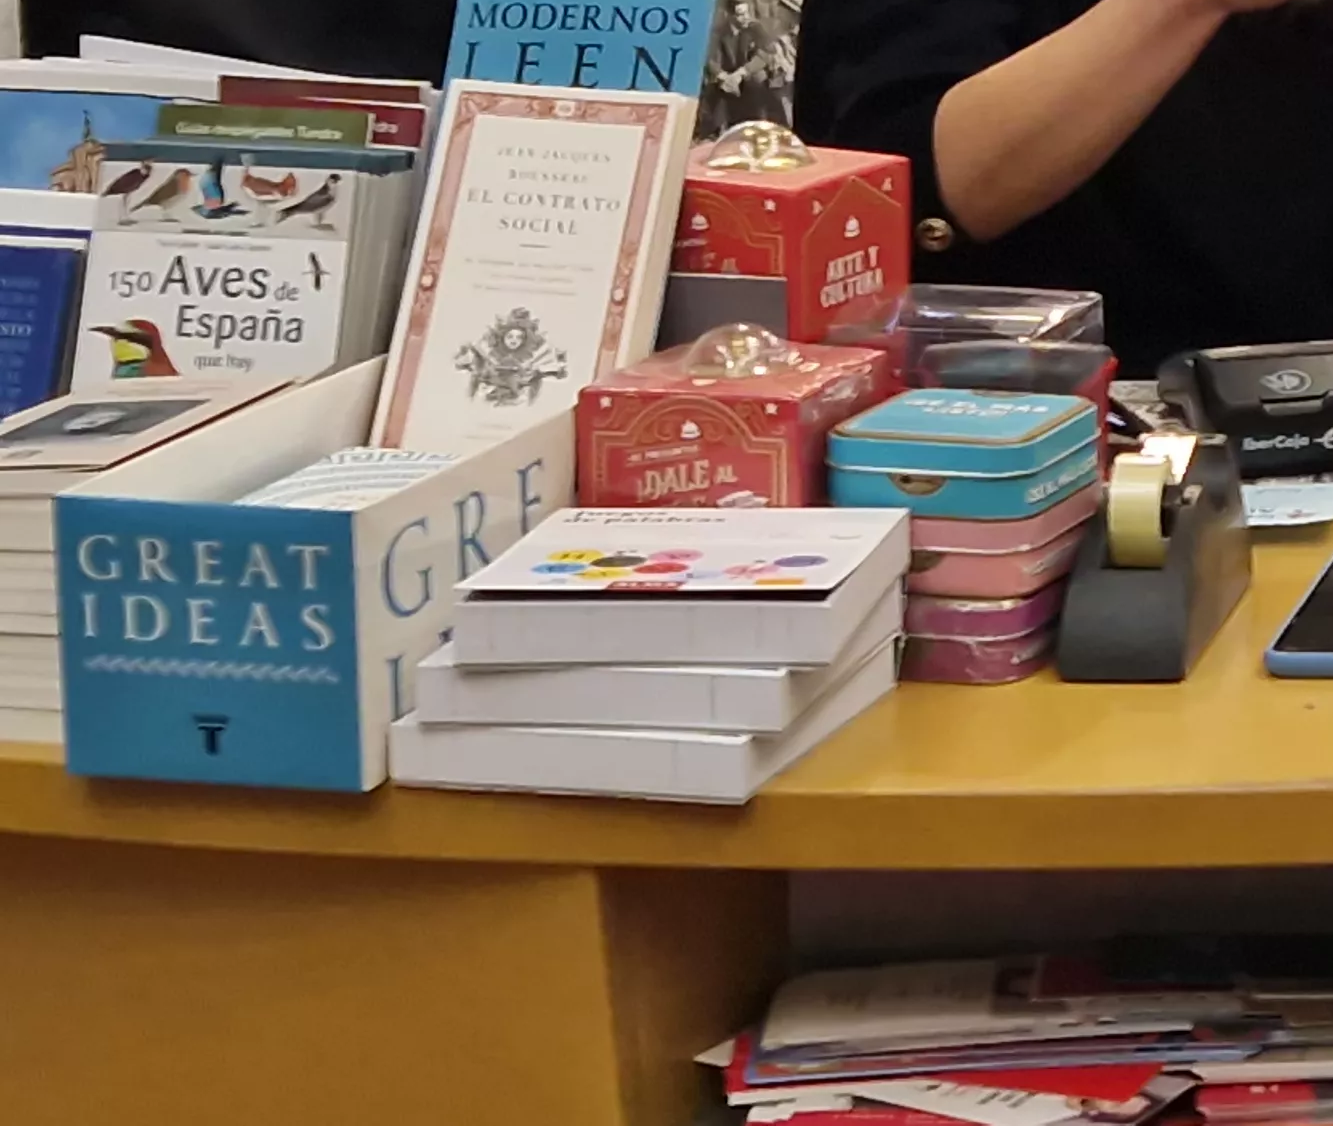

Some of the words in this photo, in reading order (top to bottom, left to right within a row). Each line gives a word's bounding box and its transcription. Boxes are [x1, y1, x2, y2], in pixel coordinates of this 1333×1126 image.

[467, 2, 691, 36] MODERNOS
[502, 191, 622, 212] CONTRATO
[498, 217, 580, 236] SOCIAL
[107, 269, 154, 299] 150
[158, 253, 269, 300] Aves
[273, 280, 300, 302] de
[174, 303, 305, 349] España
[76, 533, 331, 591] GREAT
[380, 457, 545, 620] GRE
[82, 593, 335, 652] IDEAS
